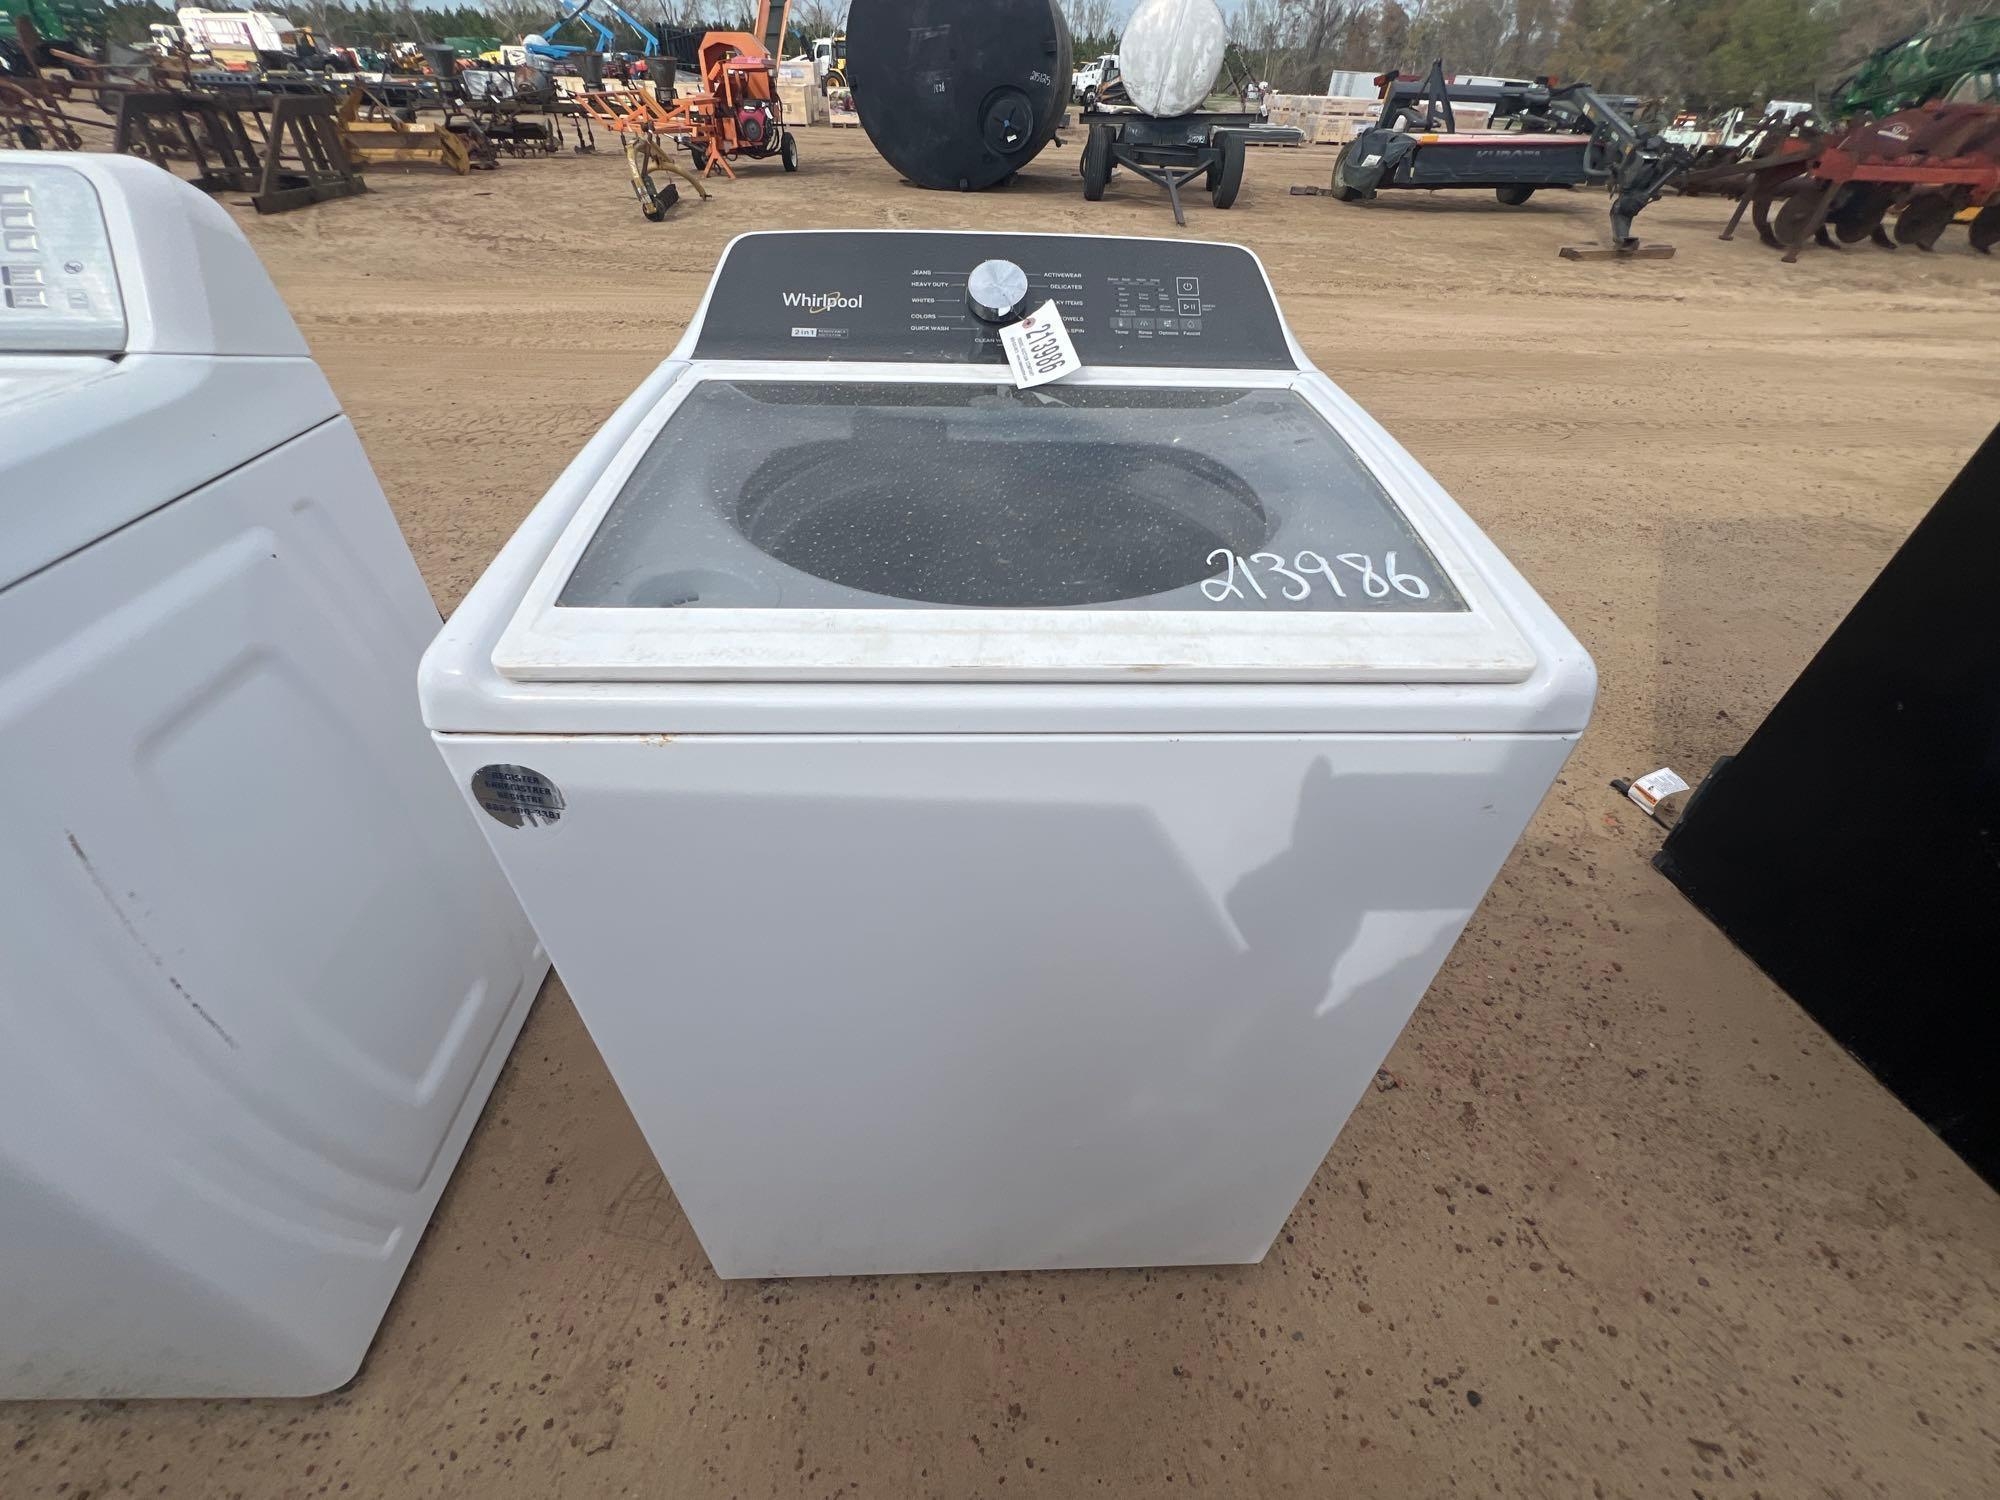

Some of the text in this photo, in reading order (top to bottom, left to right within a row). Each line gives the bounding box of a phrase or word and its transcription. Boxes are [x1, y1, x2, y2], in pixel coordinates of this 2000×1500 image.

[782, 292, 863, 312] Whirlpool
[1025, 323, 1066, 374] 213986
[1200, 548, 1430, 602] 213986
[491, 772, 540, 785] REGISTER
